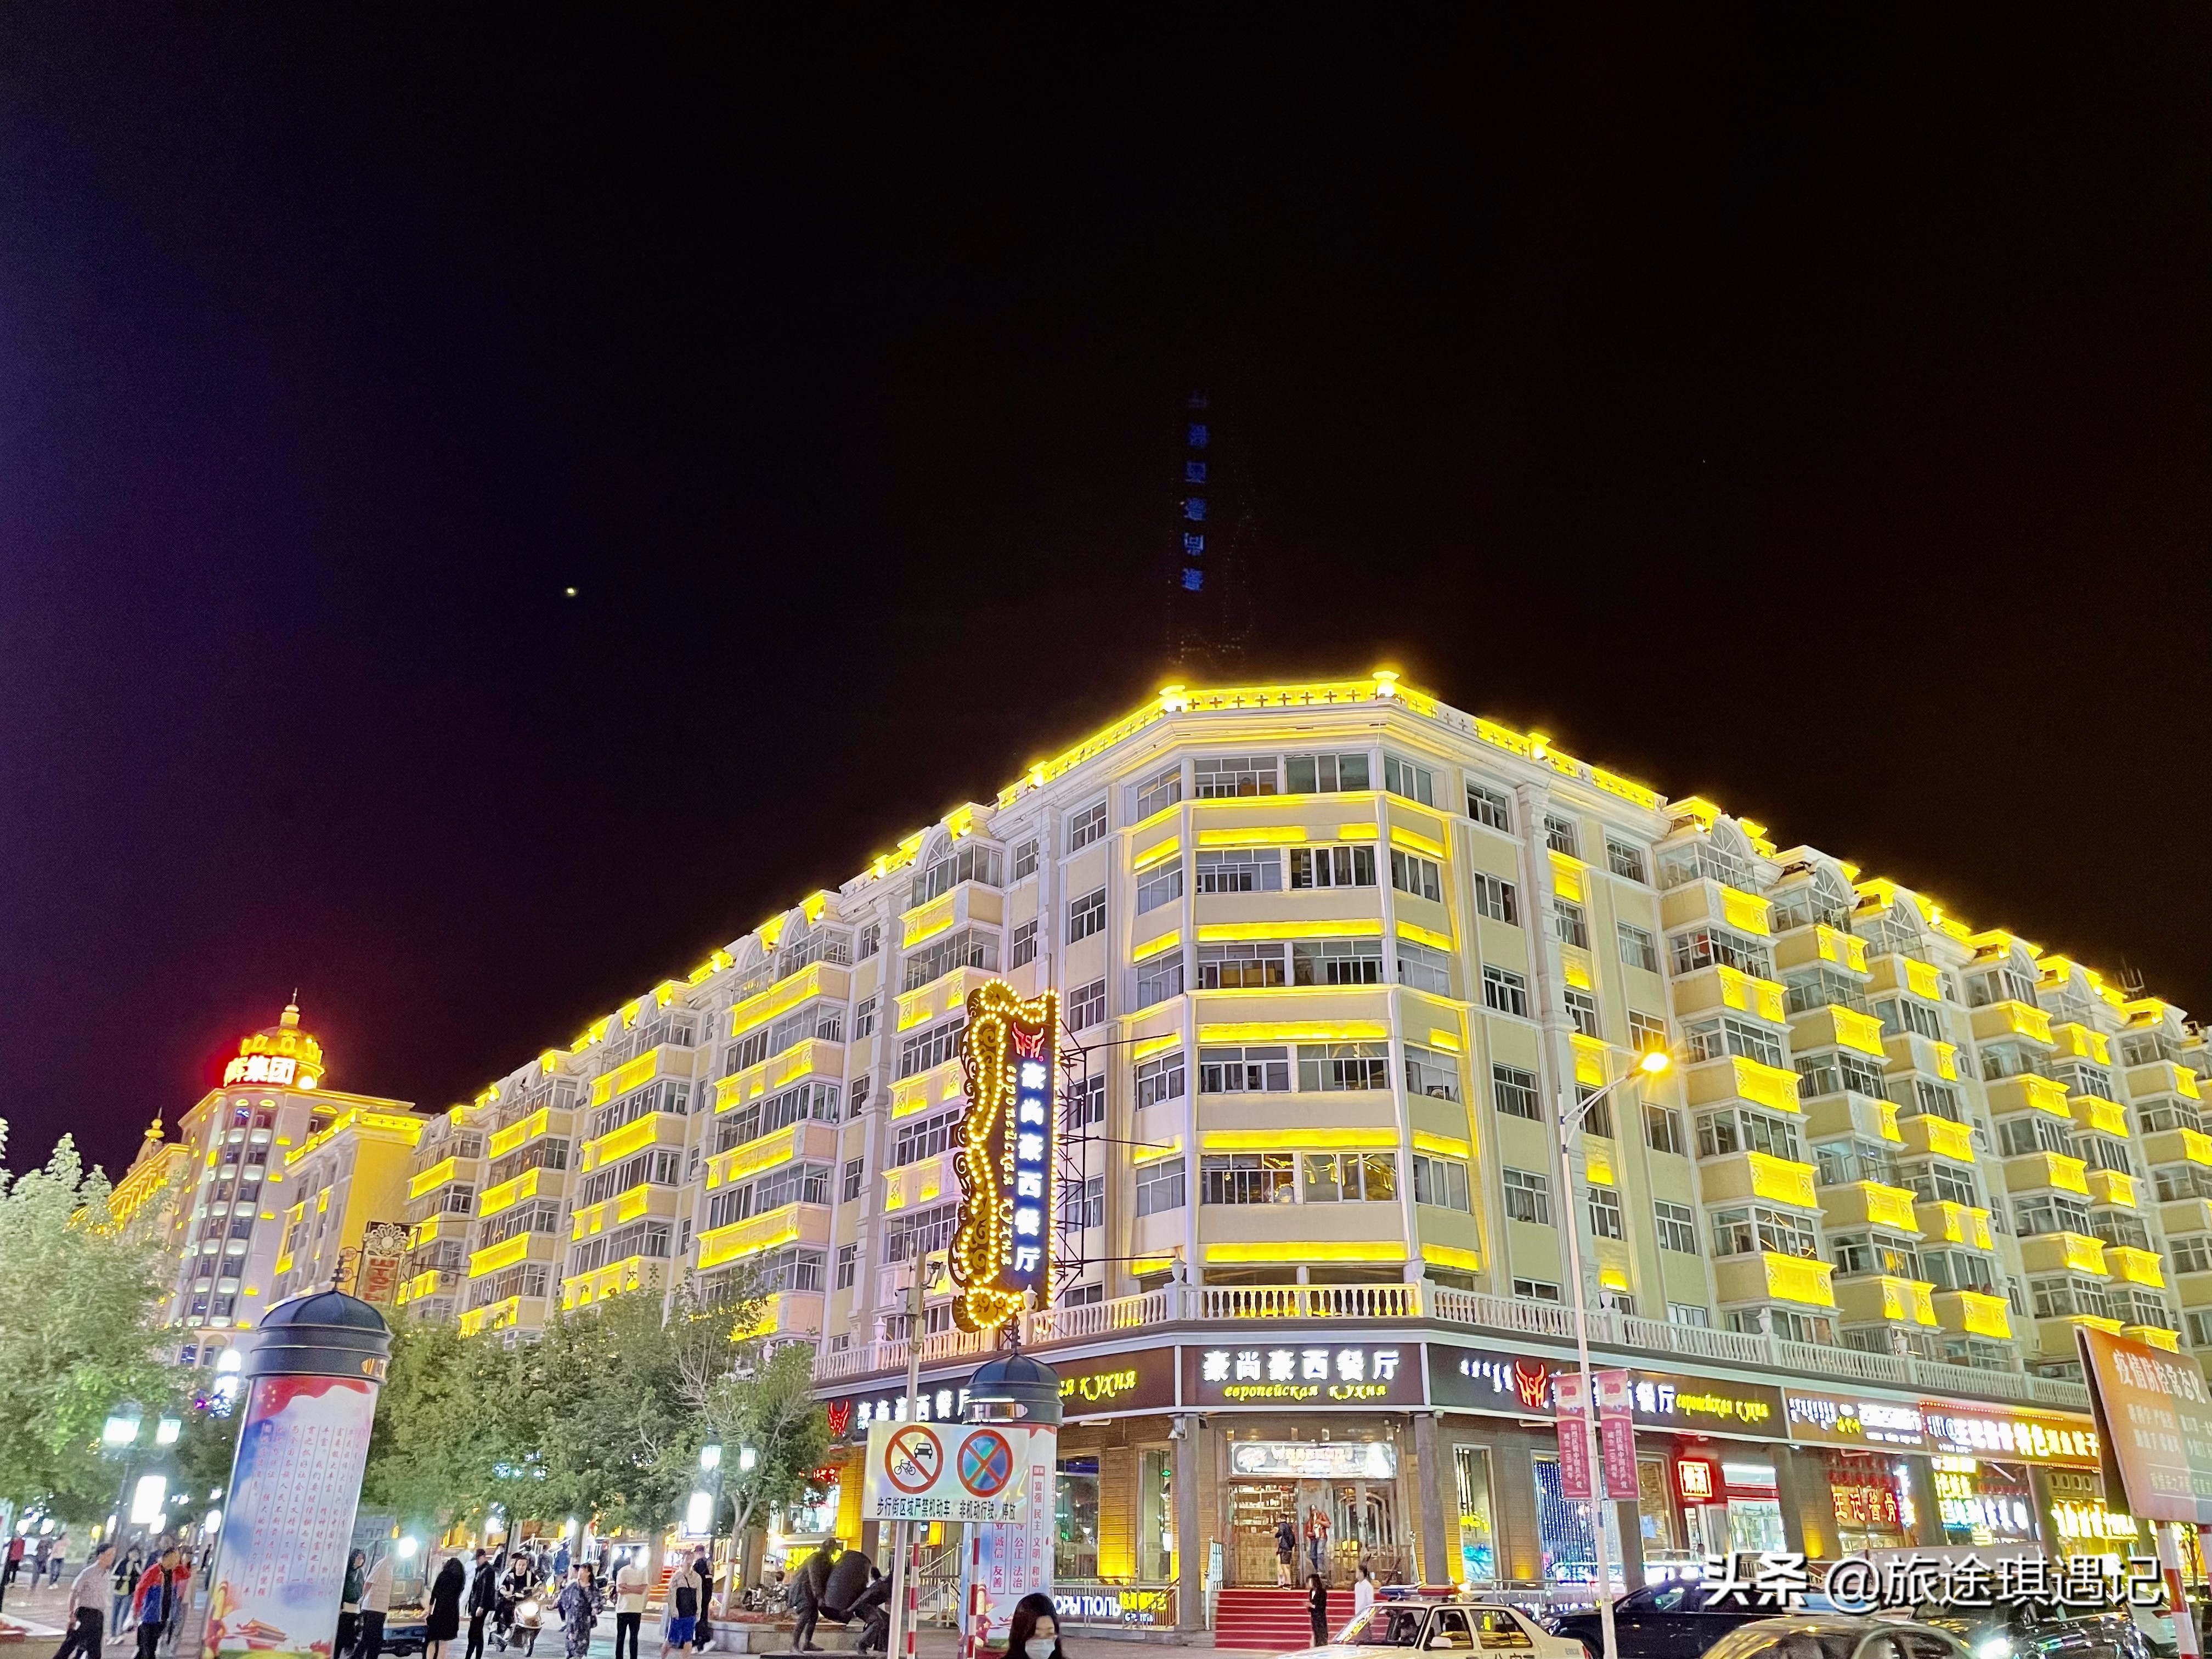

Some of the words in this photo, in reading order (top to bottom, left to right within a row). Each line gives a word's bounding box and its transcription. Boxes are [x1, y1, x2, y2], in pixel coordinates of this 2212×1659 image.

[1000, 1064, 1017, 1186] европейская
[1015, 1062, 1046, 1272] 豪尚豪西餐厅
[998, 1198, 1014, 1266] кухня
[1203, 1349, 1400, 1381] 豪尚豪西餐厅
[2113, 1349, 2205, 1403] 疫情防控常态化
[1080, 1370, 1135, 1401] кухня
[1224, 1384, 1318, 1402] европейская
[1329, 1385, 1386, 1400] кухня
[1034, 1481, 1042, 1503] 富强
[1832, 1488, 1897, 1522] 王记酱骨
[1034, 1509, 1042, 1531] 民主
[994, 1537, 1004, 1559] 诚信
[1014, 1538, 1024, 1559] 公正
[1032, 1537, 1040, 1559] 文明
[994, 1566, 1002, 1588] 友善
[1013, 1566, 1023, 1588] 法治
[1032, 1566, 1040, 1588] 和谐
[1082, 1596, 1121, 1616] ТЮЛЬ
